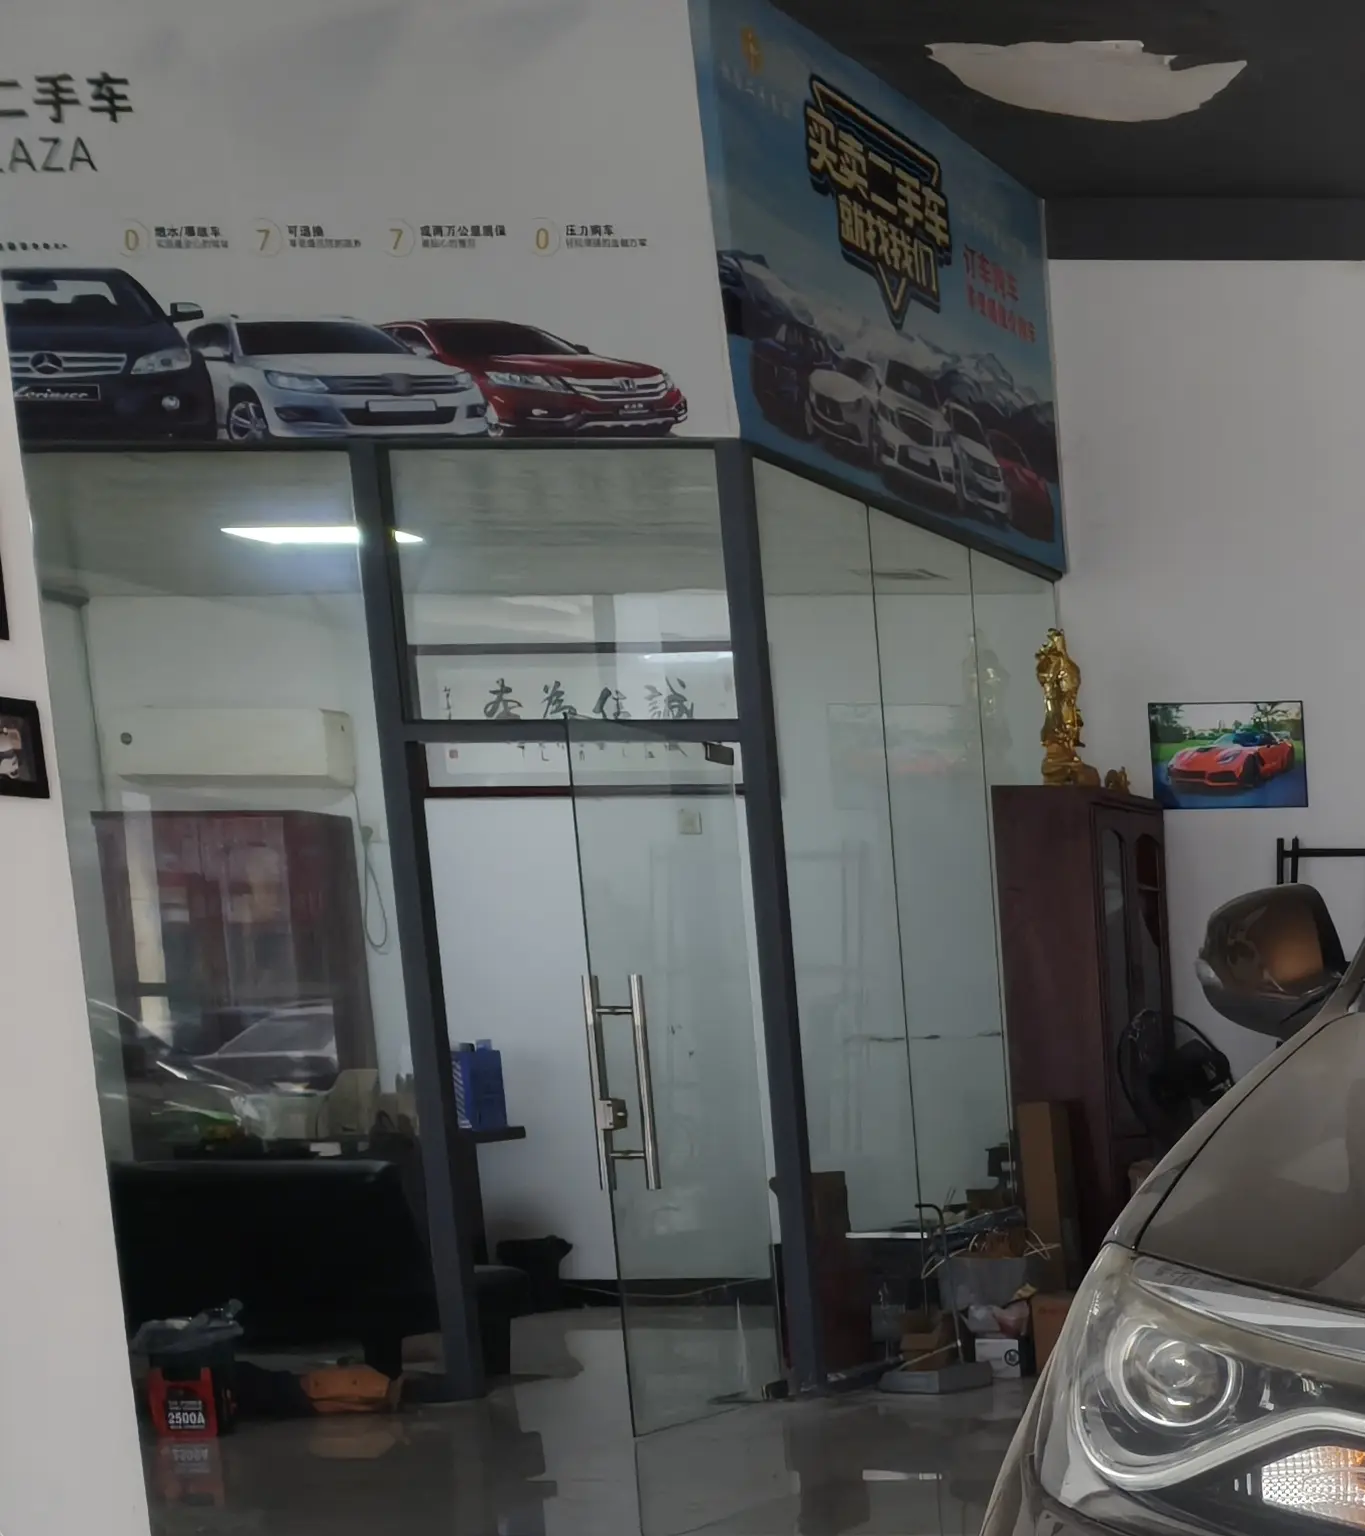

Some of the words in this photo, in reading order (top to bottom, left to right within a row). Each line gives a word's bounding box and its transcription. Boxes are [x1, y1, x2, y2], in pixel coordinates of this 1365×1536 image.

[0, 71, 134, 124] 二手车
[0, 136, 98, 172] AZA
[806, 107, 950, 246] 买卖二手车
[256, 228, 271, 251] 7
[388, 228, 404, 250] 7
[837, 194, 938, 293] 就找我们
[167, 1411, 206, 1425] 2500A
